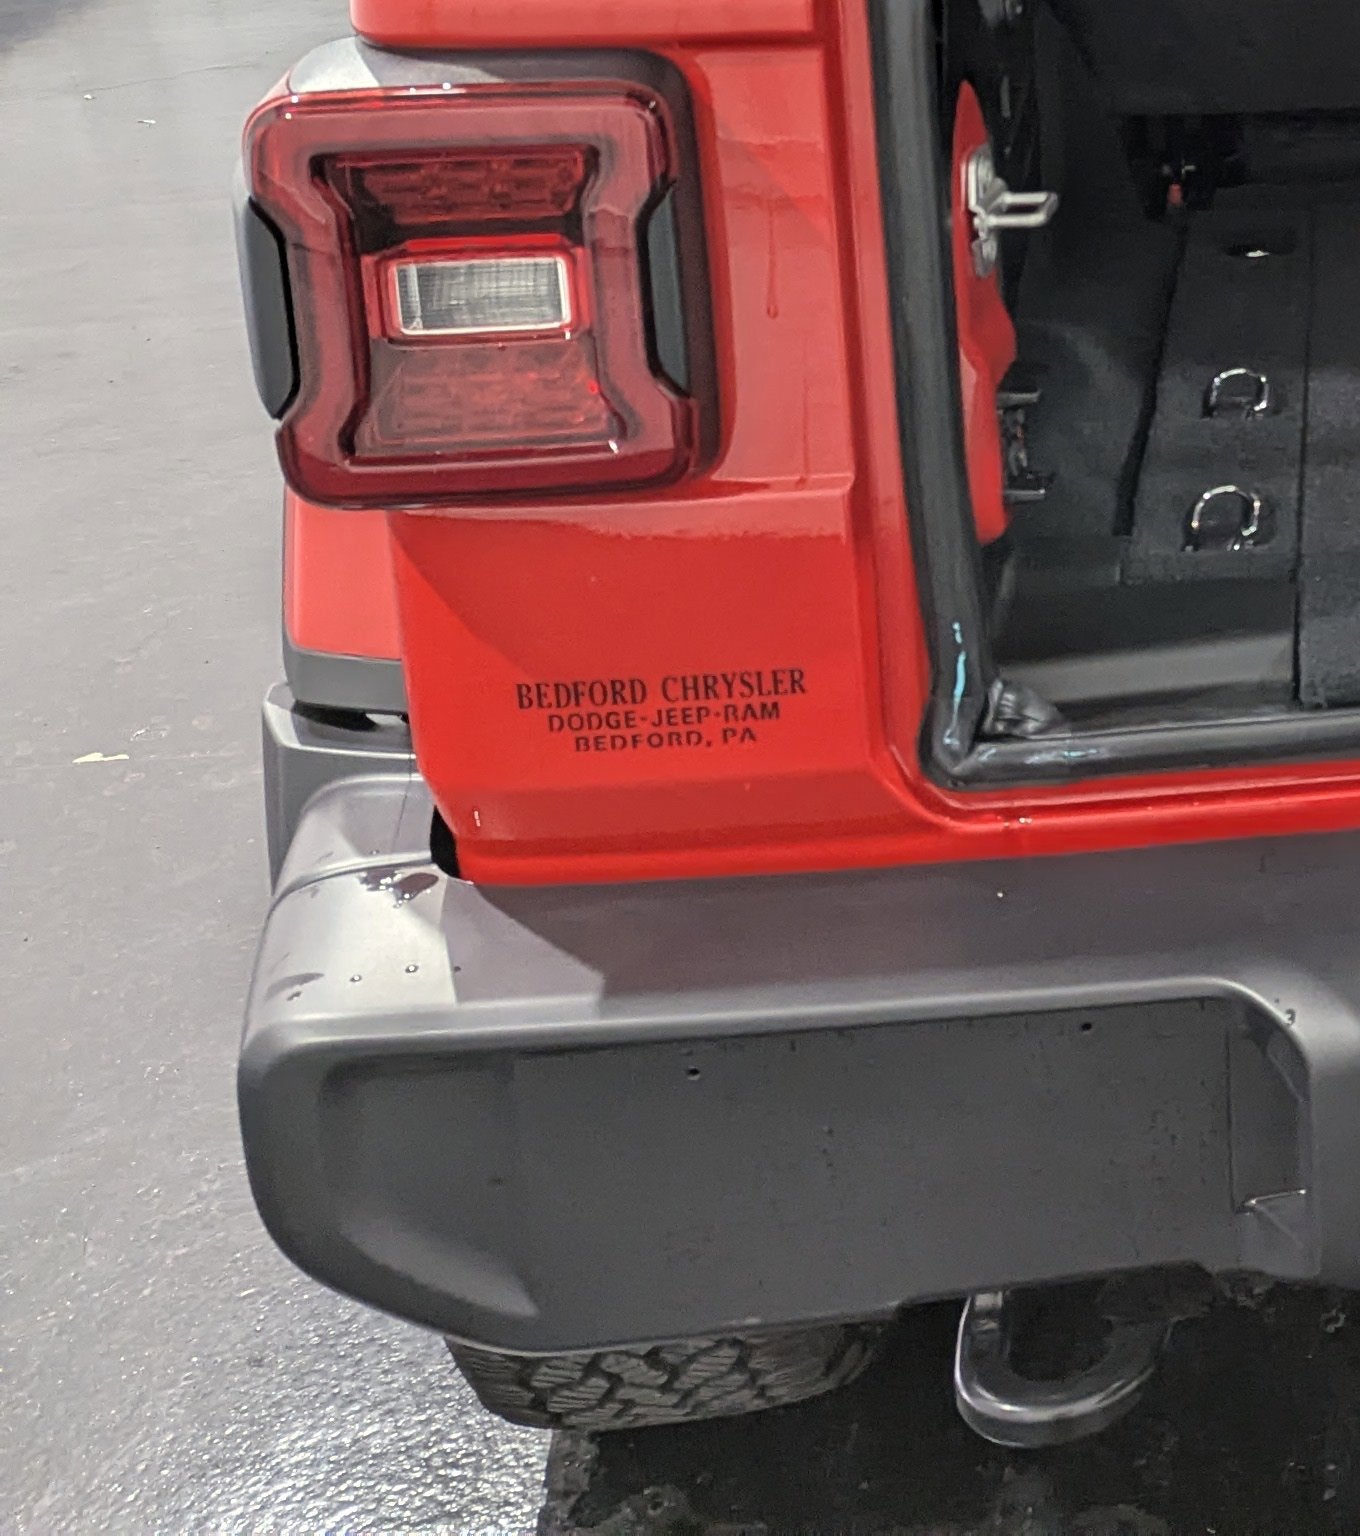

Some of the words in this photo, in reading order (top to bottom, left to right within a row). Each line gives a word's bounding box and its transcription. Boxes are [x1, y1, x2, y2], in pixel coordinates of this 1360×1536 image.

[515, 678, 648, 710] BEDFORD
[660, 668, 807, 703] CHRYSLER
[574, 730, 713, 753] BEDFORD,
[721, 727, 758, 745] PA
